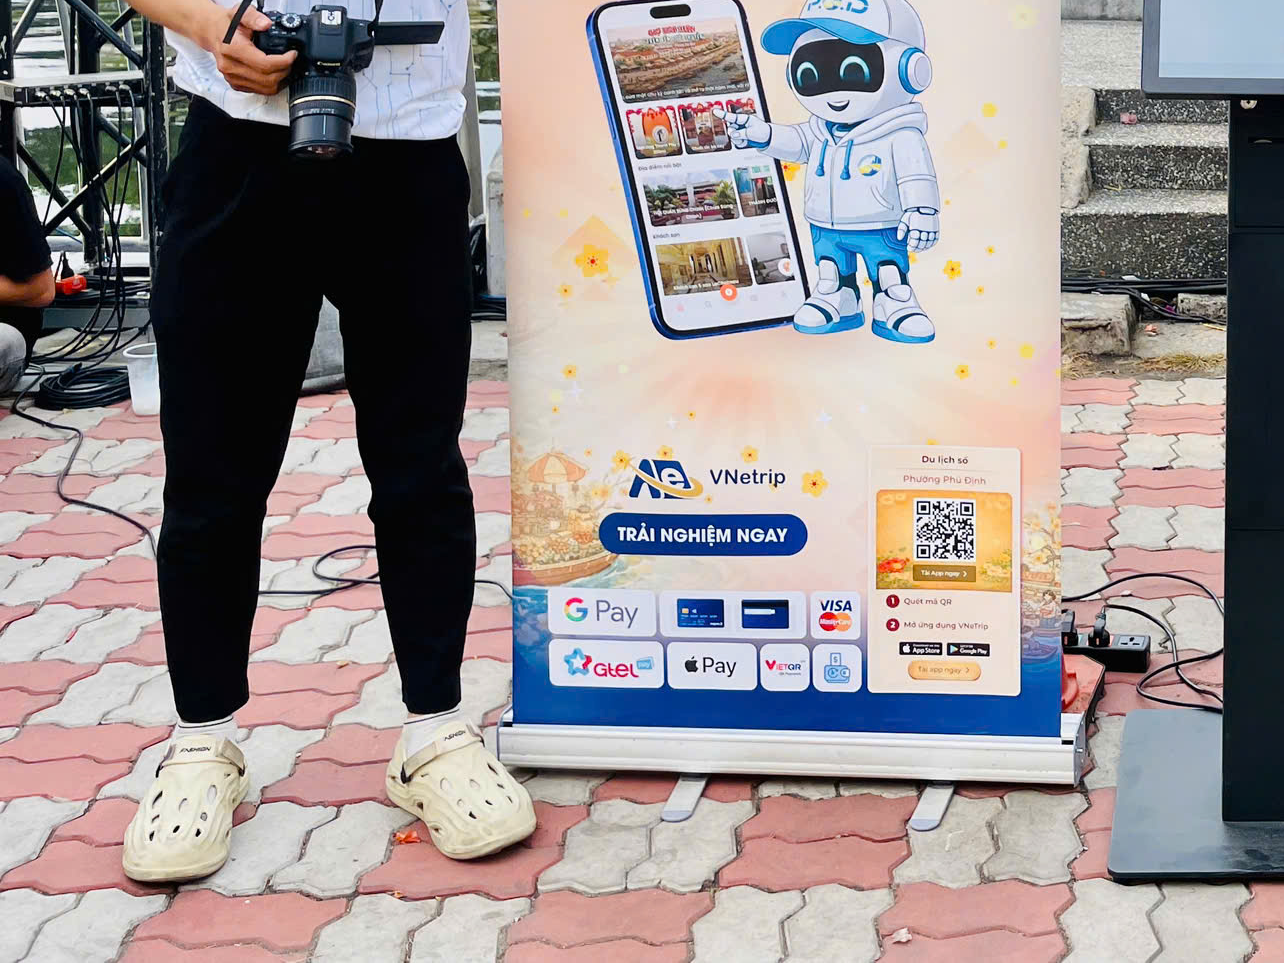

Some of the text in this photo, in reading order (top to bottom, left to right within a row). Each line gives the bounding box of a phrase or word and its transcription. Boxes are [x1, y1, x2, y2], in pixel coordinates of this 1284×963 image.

[922, 455, 935, 463] Du
[938, 455, 955, 465] lịch
[709, 468, 786, 487] VNetrip
[617, 522, 788, 546] TRẢI NGHIỆM NGAY
[819, 599, 852, 612] VISA
[940, 598, 952, 606] QR
[596, 599, 638, 629] Pay
[702, 656, 737, 678] Pay
